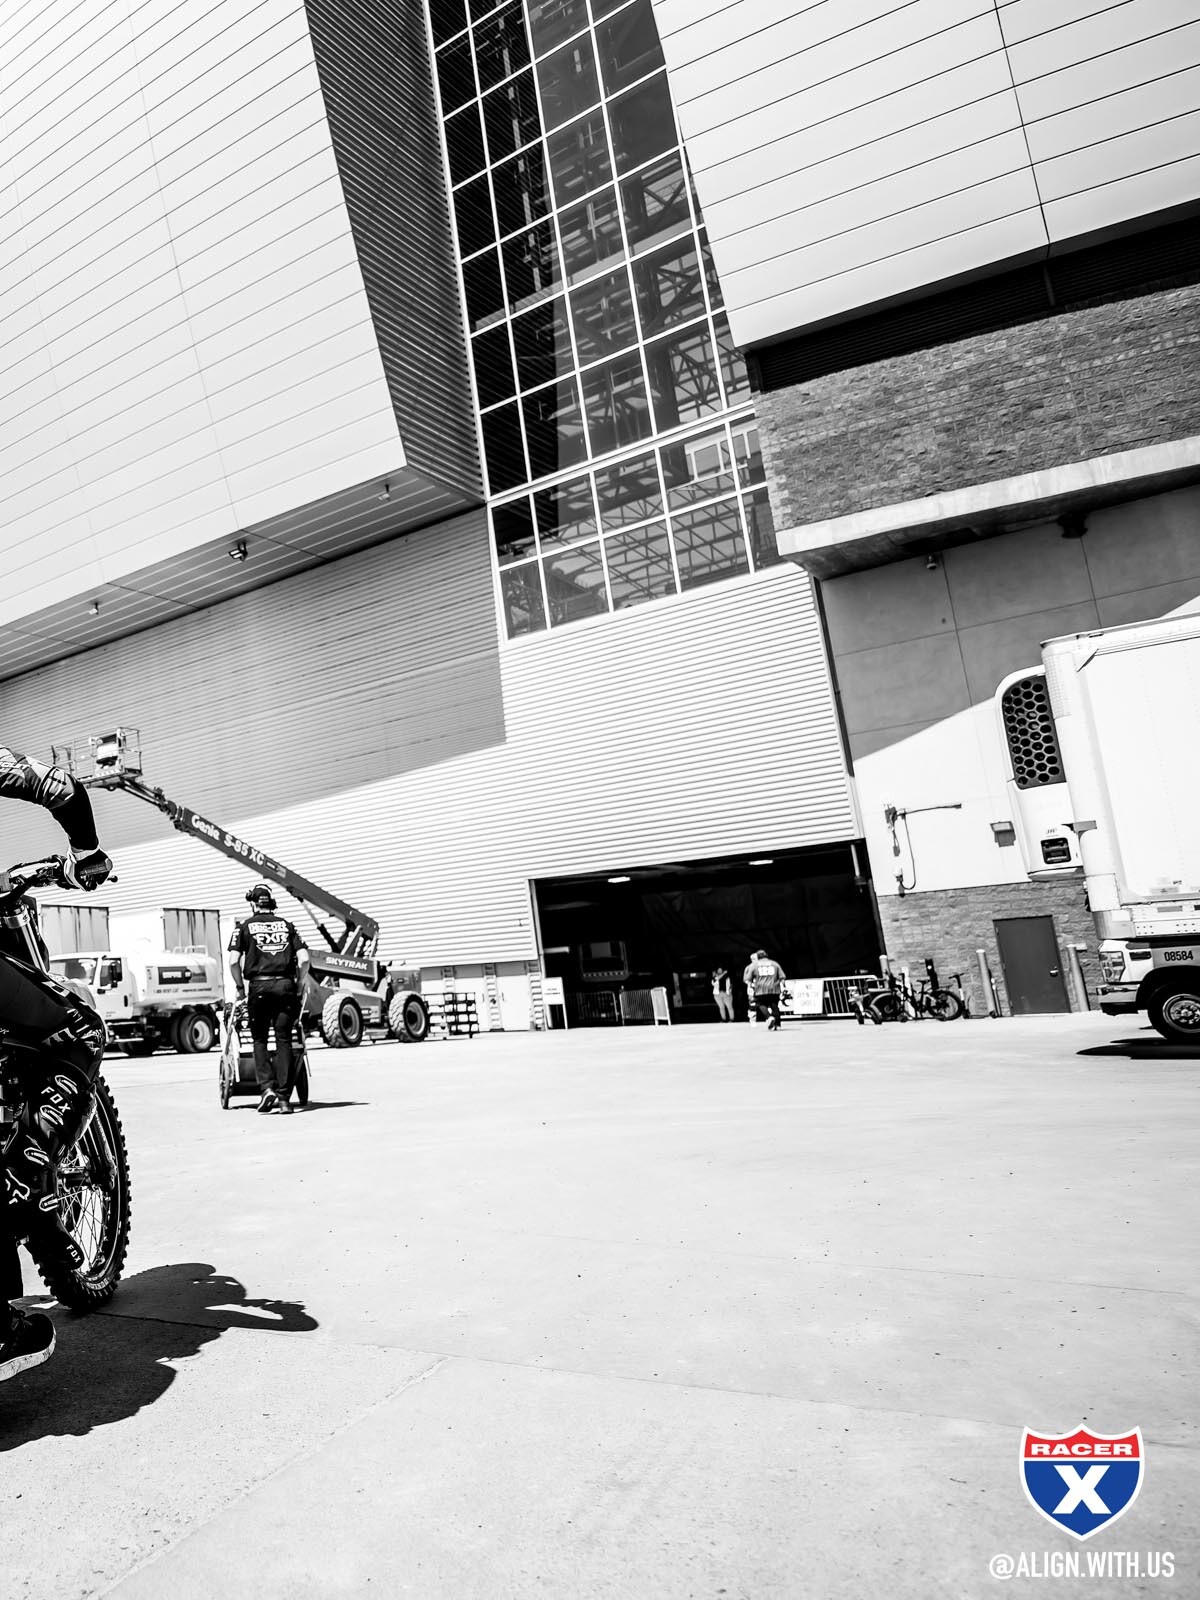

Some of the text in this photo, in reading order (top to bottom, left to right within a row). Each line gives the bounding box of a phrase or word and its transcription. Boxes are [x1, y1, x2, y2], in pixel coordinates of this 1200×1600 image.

[191, 814, 265, 866] Genie S-85 XC
[325, 956, 368, 971] SKYTRAK
[1163, 950, 1195, 962] 08584
[41, 1086, 72, 1113] FOX
[66, 1244, 81, 1262] FOX
